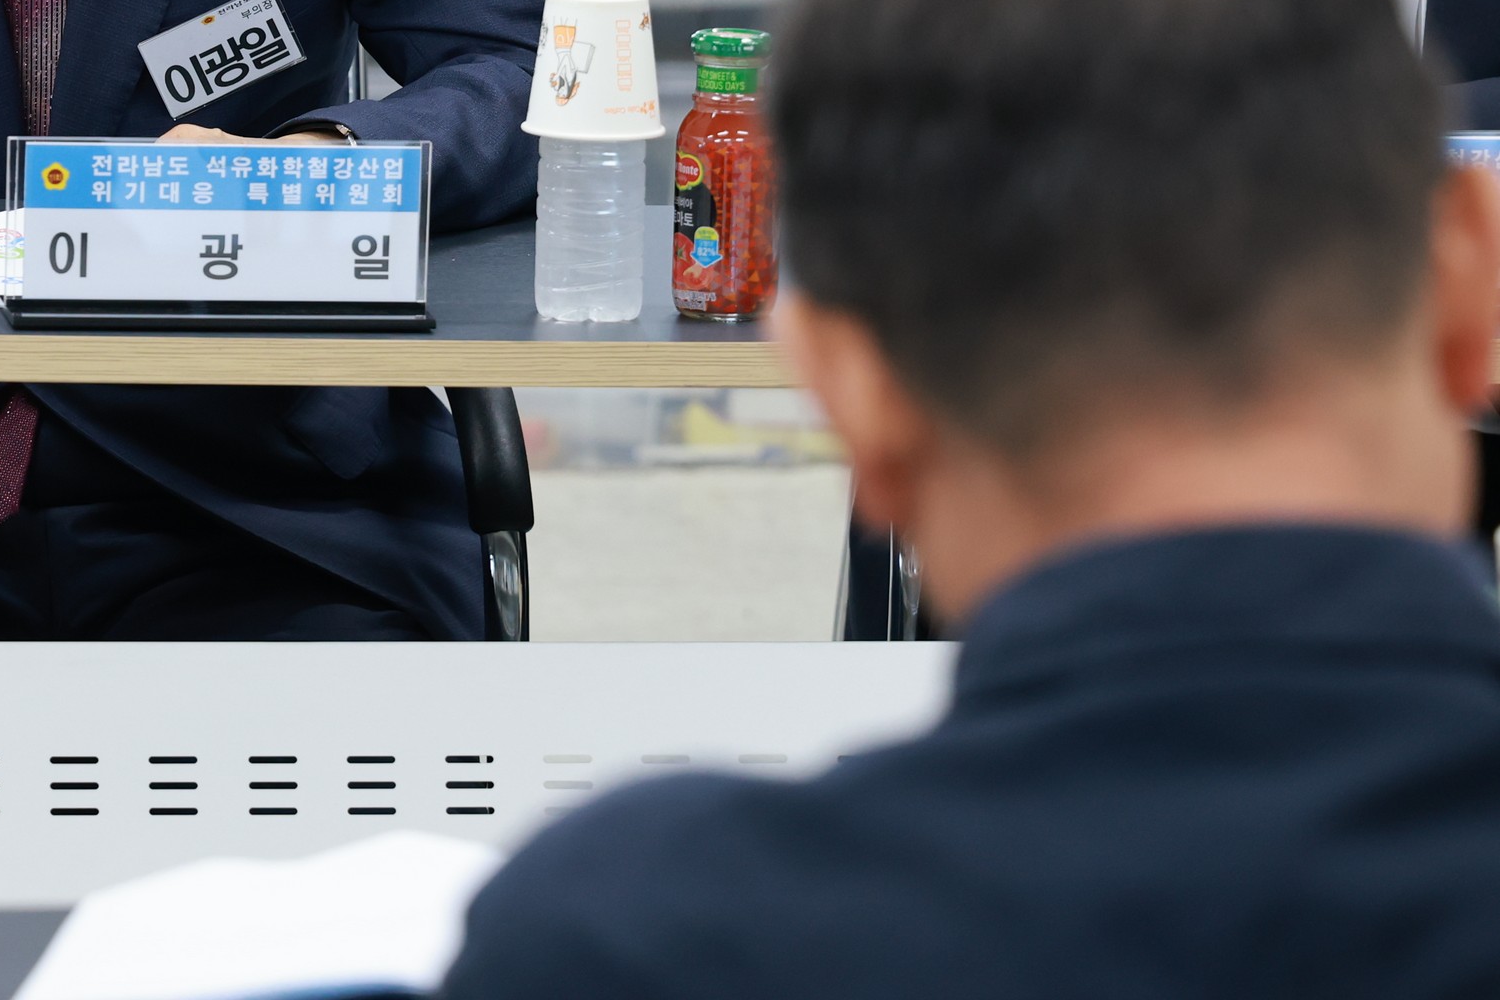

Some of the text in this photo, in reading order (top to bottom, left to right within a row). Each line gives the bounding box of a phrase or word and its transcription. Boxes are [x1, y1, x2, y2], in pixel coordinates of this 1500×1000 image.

[164, 18, 291, 103] 이광일
[724, 81, 746, 91] DAYS
[91, 154, 405, 181] 전라남도 석유화학철강산업
[91, 181, 404, 206] 위기대응 특별위원회
